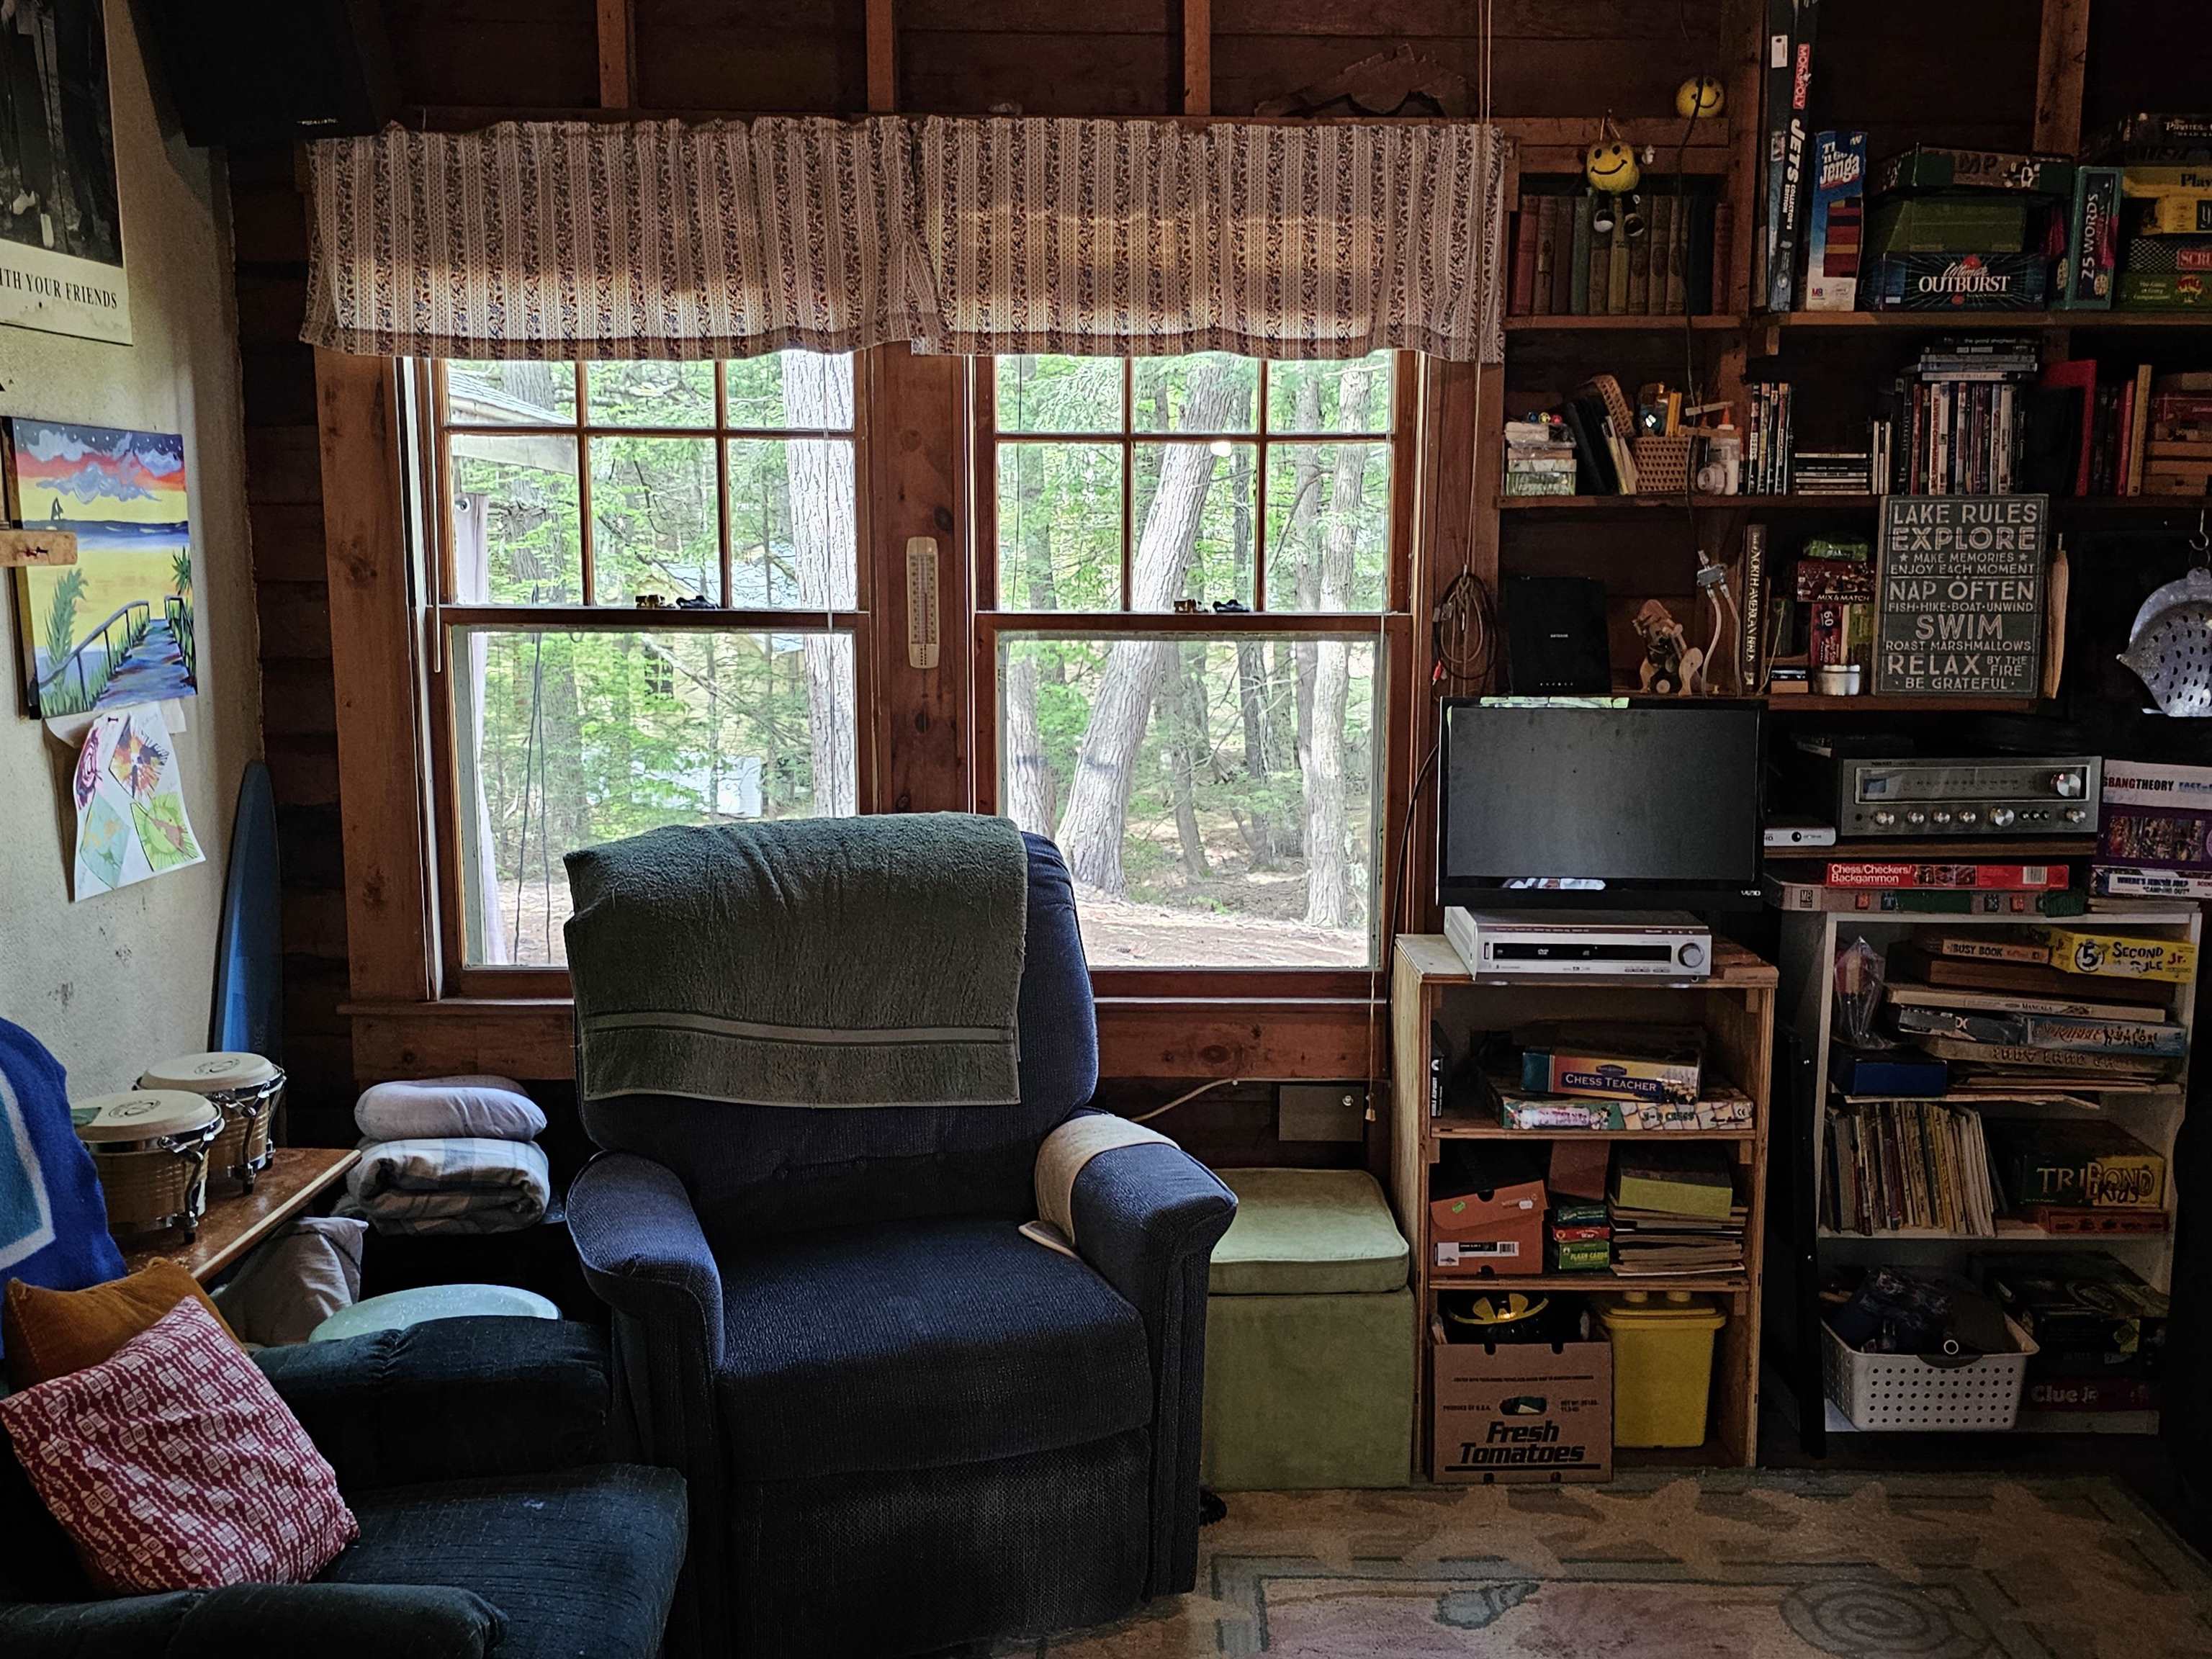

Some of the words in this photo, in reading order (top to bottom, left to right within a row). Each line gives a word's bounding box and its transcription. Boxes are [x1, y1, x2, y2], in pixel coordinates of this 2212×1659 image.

[1794, 45, 1809, 108] MONOPOLY
[1787, 118, 1806, 183] JETS
[1786, 184, 1797, 230] COLLECTOR'S
[2084, 193, 2099, 253] WORDS
[2082, 252, 2095, 279] 25
[0, 269, 22, 289] ITH
[26, 274, 62, 298] YOUR
[66, 283, 117, 309] FRIENDS
[1918, 275, 2011, 293] OUTBURST
[1894, 504, 1950, 525] LAKE
[1961, 503, 2038, 524] RULES
[1892, 526, 2036, 551] EXPLORE
[1750, 549, 1762, 587] NORTH
[1891, 565, 1934, 575] ENJOY
[1939, 564, 1972, 575] EACH
[1977, 563, 2035, 575] MOMENT
[1913, 554, 1946, 563] MAKE
[1949, 553, 2015, 563] MEMORIES
[1889, 580, 1937, 601] NAP
[1947, 580, 2035, 601] OFTEN
[1747, 587, 1759, 634] AMERICAN
[1823, 610, 1834, 627] 60
[1915, 613, 2003, 640] SWIM
[1745, 637, 1756, 662] BIRDS
[1885, 641, 1926, 651] ROAST
[1930, 640, 2032, 651] MARSHMALLOWS
[1887, 652, 1981, 675] RELAX
[1987, 655, 2002, 665] BY
[2006, 655, 2028, 665] THE
[1990, 665, 2023, 677] FIRE
[1905, 677, 1925, 689] BE
[1931, 677, 2008, 689] GRATEFUL
[1831, 864, 1912, 874] Chess/Checkers/
[1831, 873, 1899, 884] Backgammon
[1954, 944, 1976, 954] BUSY
[1979, 946, 2003, 956] BOOK
[2082, 942, 2100, 967] 5
[2113, 941, 2164, 958] SECOND
[2167, 953, 2187, 965] Jr.
[1565, 1074, 1602, 1087] CHESS
[1605, 1077, 1658, 1092] TEACHER
[2098, 1182, 2139, 1205] Kids
[2031, 1384, 2078, 1403] Clue
[1486, 1420, 1560, 1443] Fresh
[1460, 1442, 1586, 1464] Tomatoes
